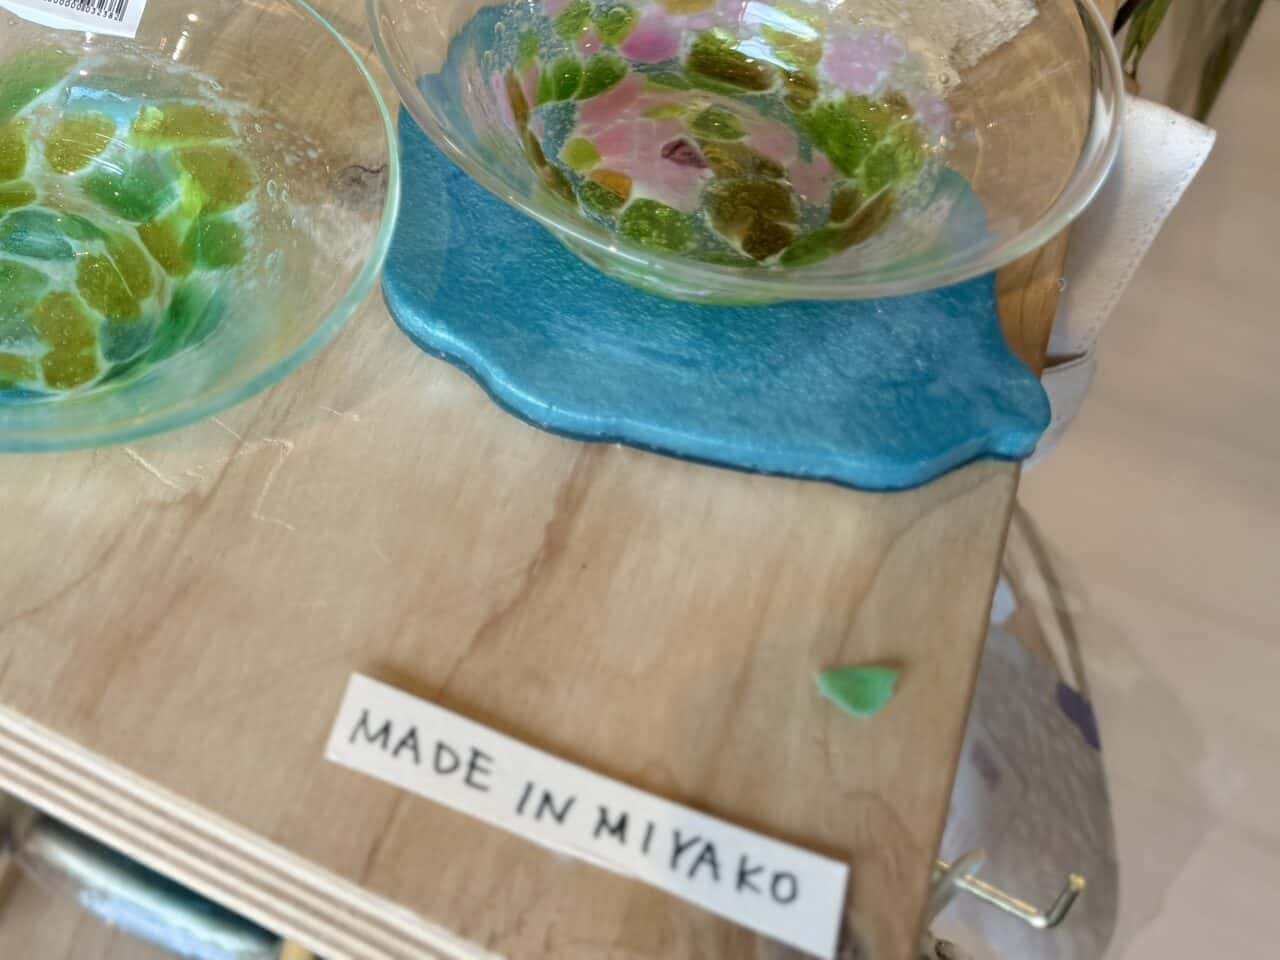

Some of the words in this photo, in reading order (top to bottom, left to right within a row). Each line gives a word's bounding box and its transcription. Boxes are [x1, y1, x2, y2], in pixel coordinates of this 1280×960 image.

[349, 708, 495, 793] MADE
[515, 780, 577, 826] IN
[592, 805, 800, 906] MIYAKO
